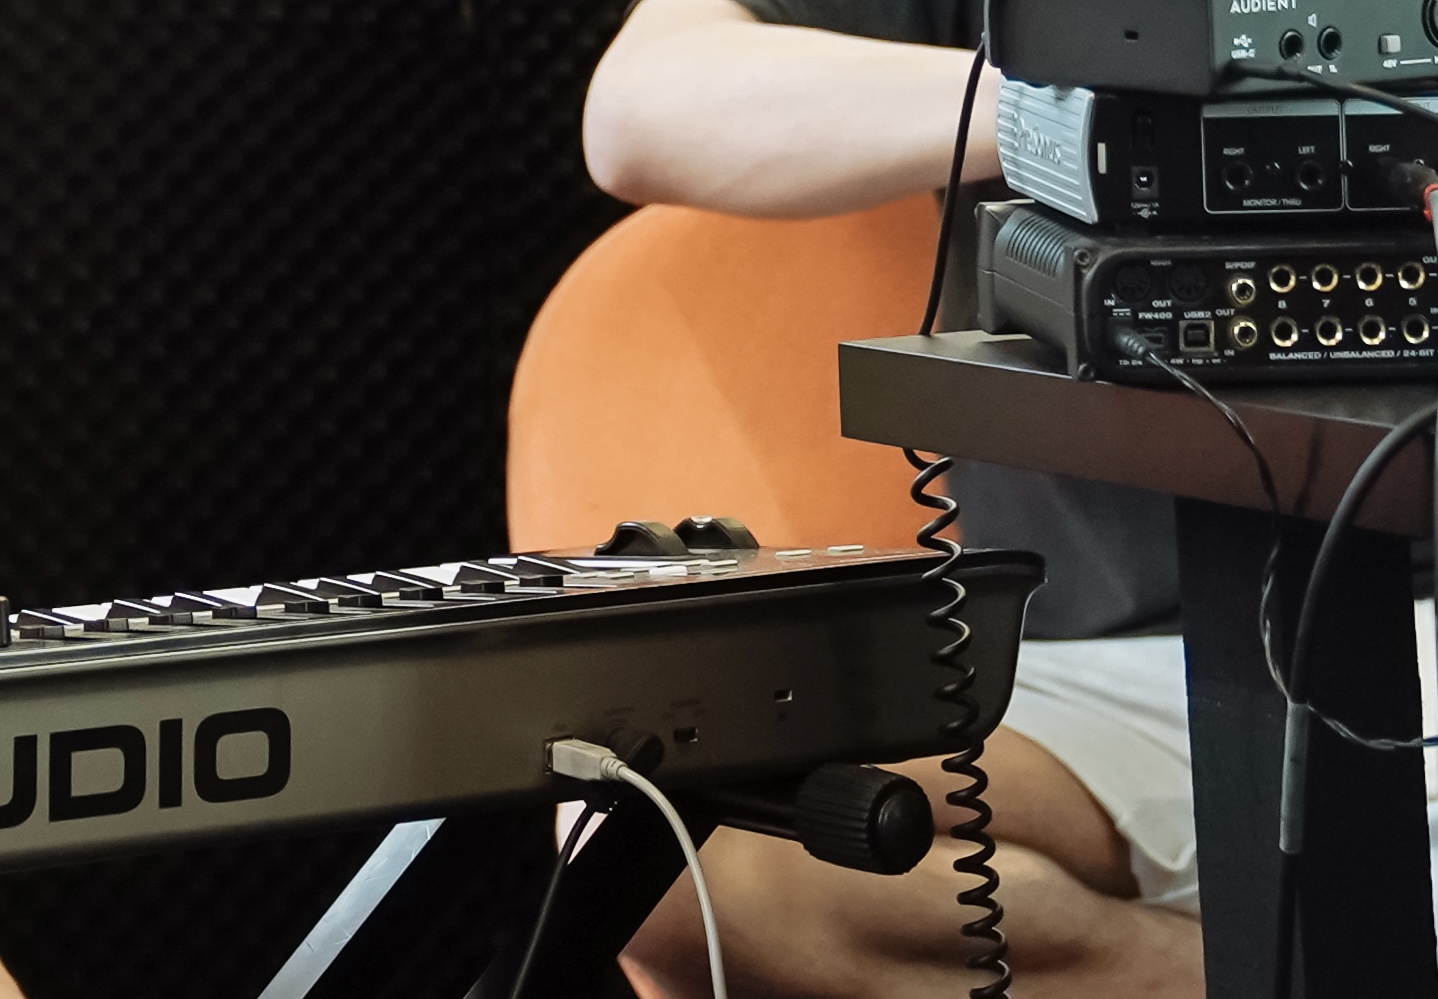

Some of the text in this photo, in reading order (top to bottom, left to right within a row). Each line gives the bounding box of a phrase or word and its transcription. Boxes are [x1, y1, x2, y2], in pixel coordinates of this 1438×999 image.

[1223, 147, 1245, 156] RIGHT
[1298, 146, 1315, 155] LEFT
[1369, 144, 1390, 153] RIGHT
[1152, 300, 1172, 308] OUT
[1322, 300, 1330, 308] 7
[1215, 308, 1235, 316] OUT
[1269, 352, 1321, 360] BALANCED
